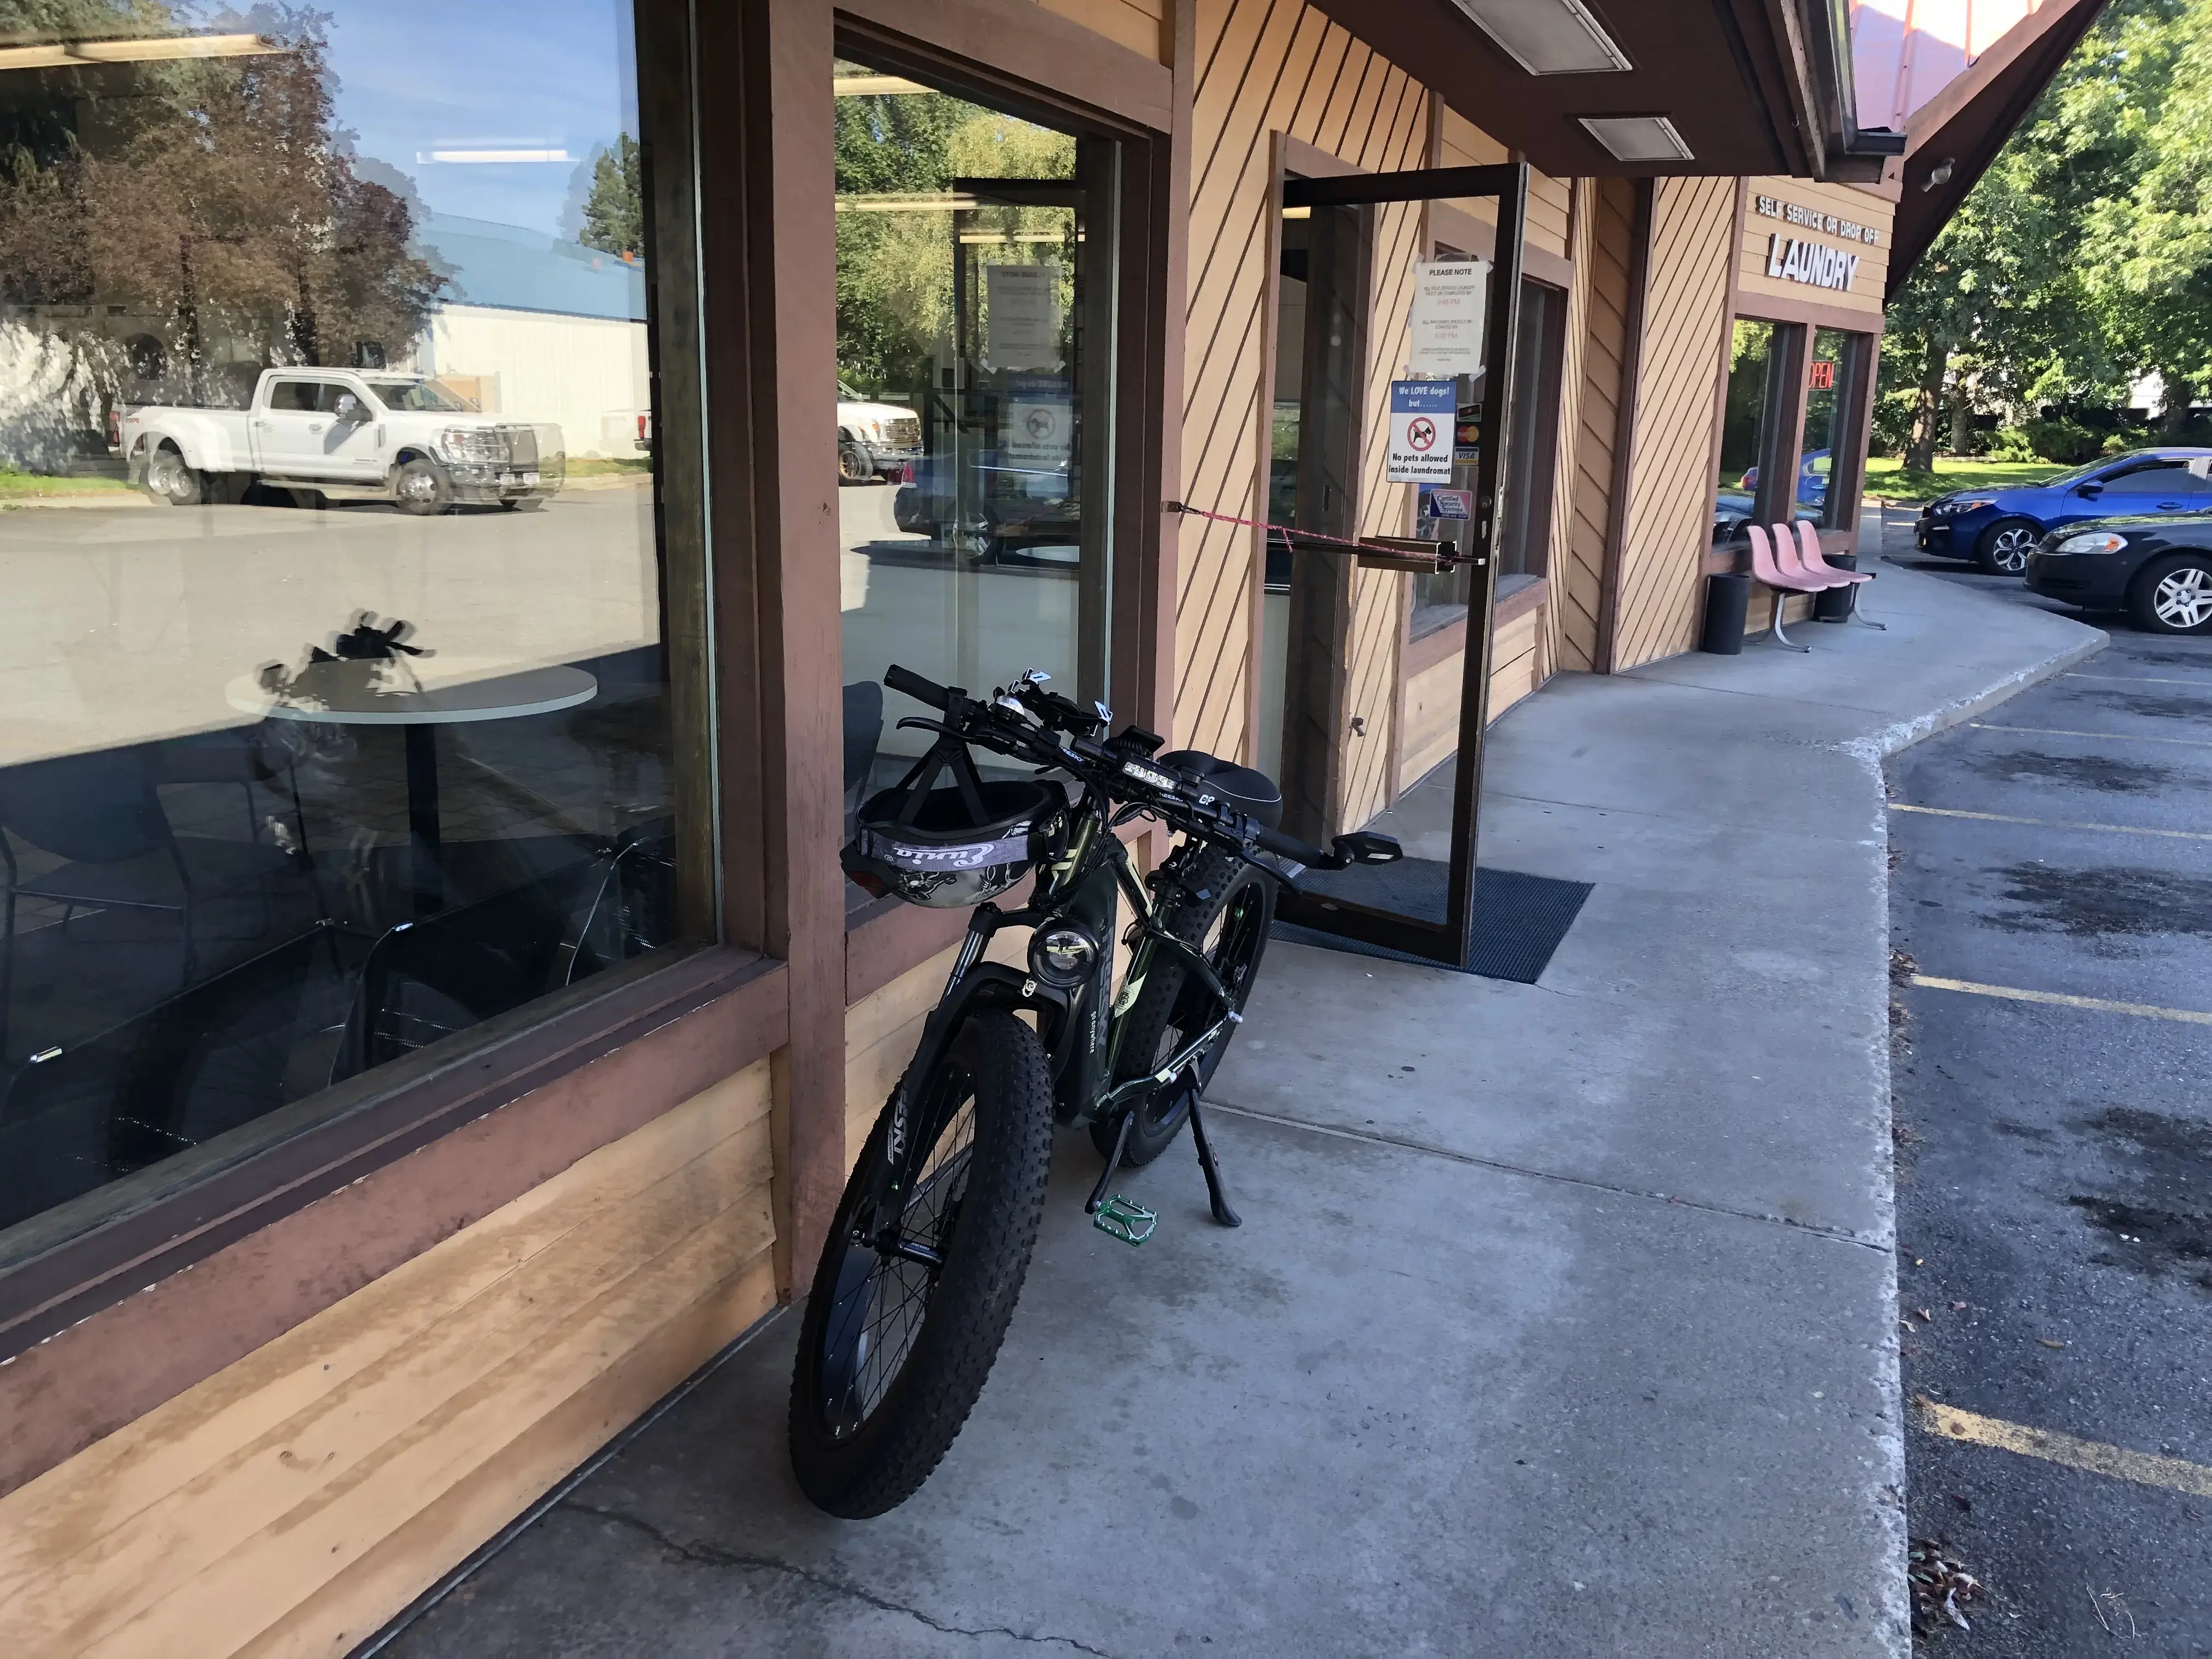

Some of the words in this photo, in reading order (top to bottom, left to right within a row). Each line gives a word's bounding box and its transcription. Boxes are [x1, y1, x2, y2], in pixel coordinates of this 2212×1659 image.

[1758, 196, 1782, 217] SELF
[1786, 204, 1823, 229] SERVICE
[1826, 216, 1837, 234] OR
[1841, 221, 1861, 240] DROP
[1864, 228, 1879, 245] OFF
[1768, 233, 1860, 291] LAUNDRY
[1808, 362, 1835, 388] OPEN
[1399, 387, 1409, 395] We
[1410, 386, 1427, 395] LOVE
[1430, 386, 1449, 398] dogs!
[1392, 453, 1402, 461] No
[1403, 454, 1419, 463] pets
[1420, 454, 1448, 462] allowed
[1389, 465, 1409, 473] inside
[1410, 465, 1451, 475] laundromat
